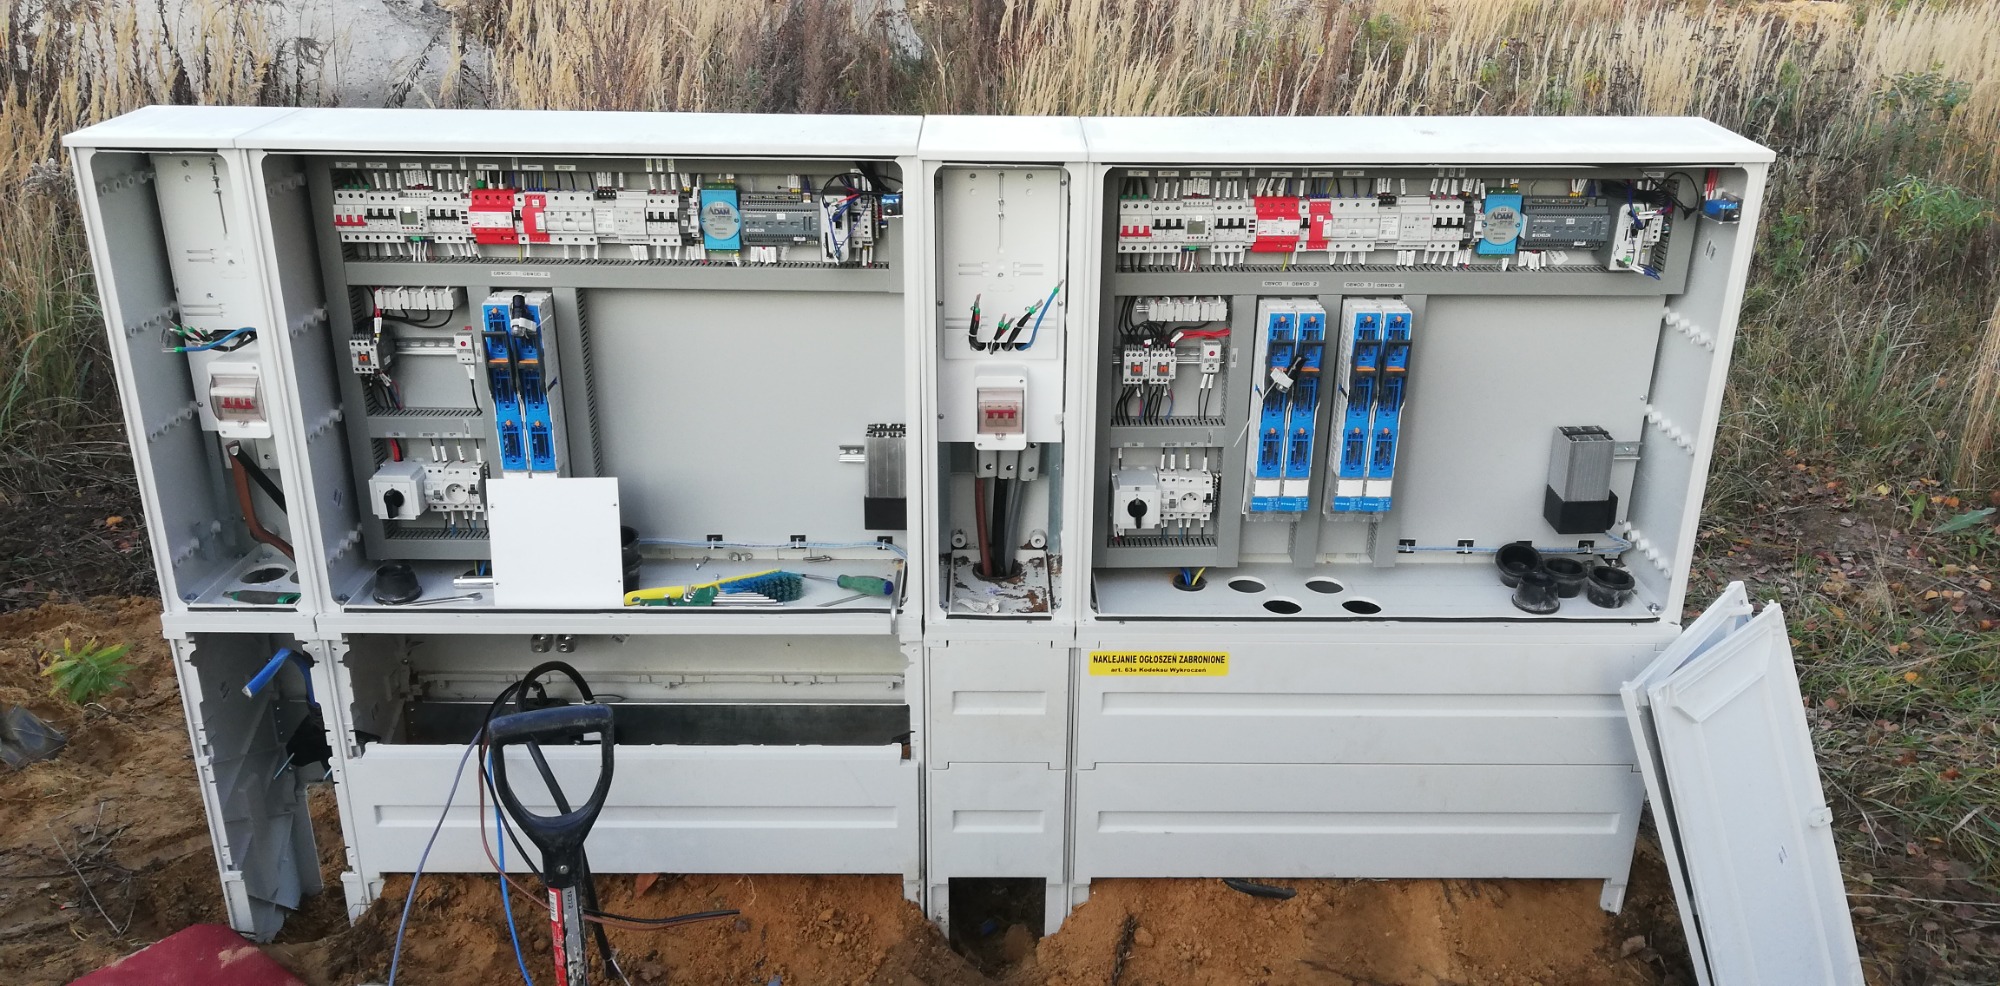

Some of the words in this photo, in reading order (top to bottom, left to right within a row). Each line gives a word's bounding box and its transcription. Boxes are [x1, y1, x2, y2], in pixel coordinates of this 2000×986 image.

[708, 206, 730, 215] ADAM
[1491, 211, 1513, 220] ADAM
[1093, 655, 1137, 663] NAKLEJANIE
[1139, 654, 1177, 664] OGŁOSZEŃ
[1179, 655, 1226, 664] ZABRONIONE
